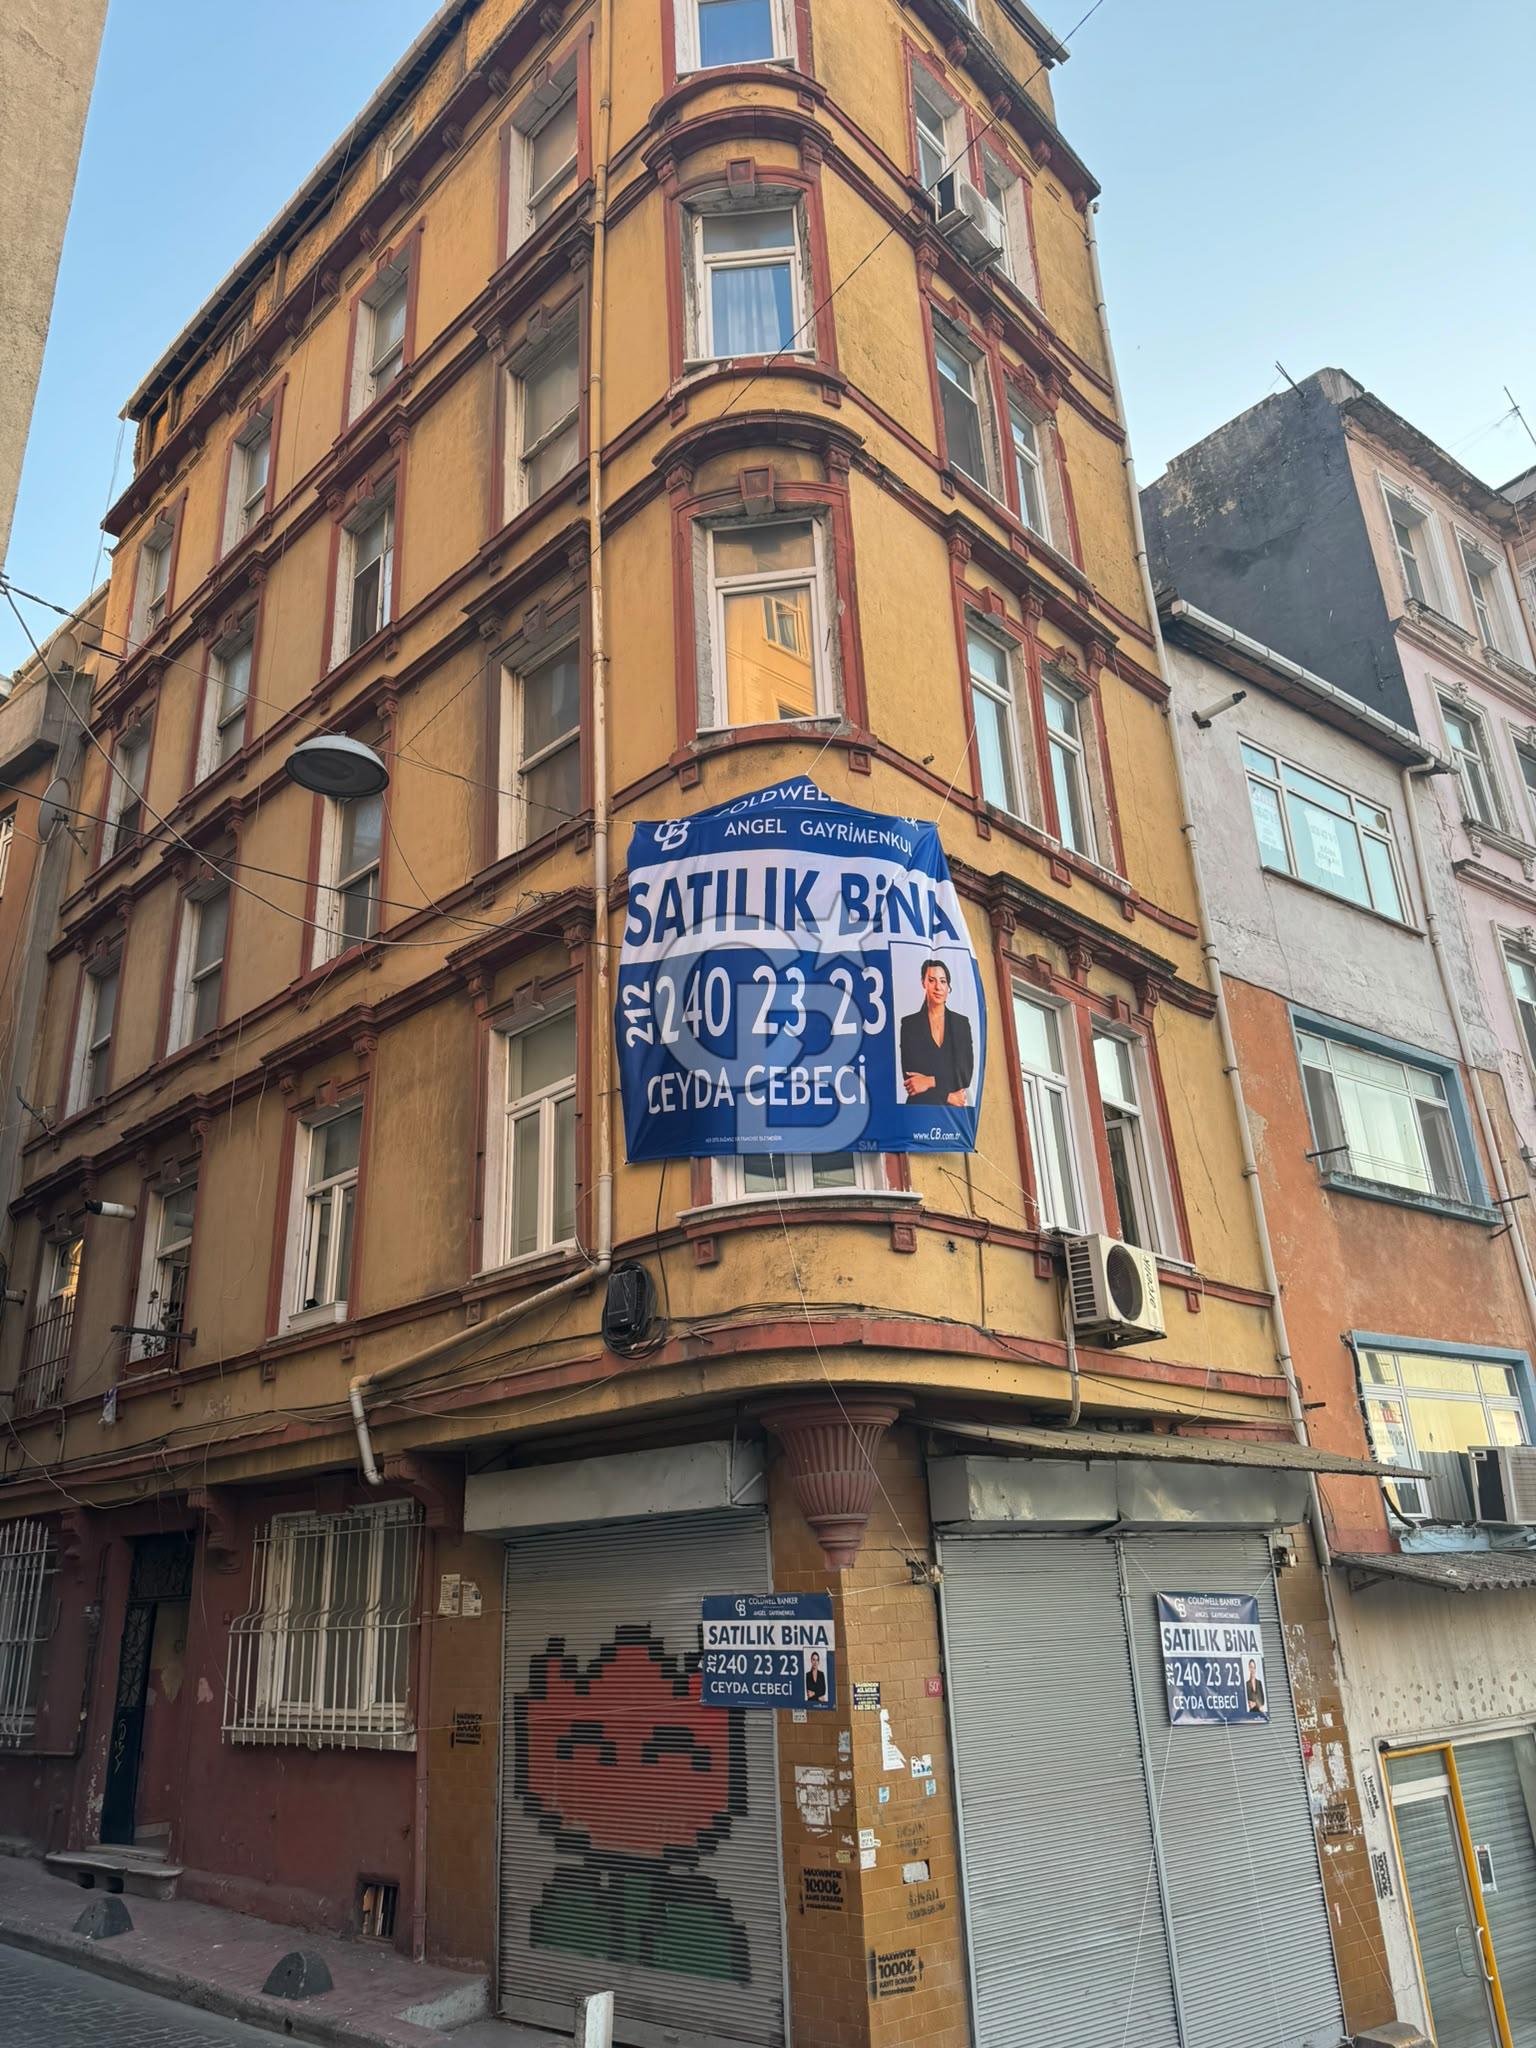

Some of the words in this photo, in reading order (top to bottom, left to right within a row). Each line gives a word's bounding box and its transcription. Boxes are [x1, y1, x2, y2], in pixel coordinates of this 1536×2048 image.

[724, 819, 787, 837] ANGEL
[625, 867, 820, 947] SATILIK
[622, 980, 654, 1048] 212
[656, 966, 731, 1045] 240
[751, 965, 807, 1037] 23
[829, 966, 887, 1036] 23
[647, 1066, 735, 1115] CEYDA
[744, 1054, 867, 1106] CEBECİ
[708, 1625, 776, 1645] SATILIK
[1163, 1627, 1221, 1652] SATILIK
[706, 1654, 718, 1674] 212
[717, 1654, 748, 1675] 240
[753, 1654, 774, 1676] 23
[779, 1654, 799, 1676] 23
[1174, 1662, 1201, 1687] 240
[1204, 1662, 1222, 1687] 23
[1225, 1662, 1241, 1687] 23
[710, 1681, 750, 1694] CEYDA
[751, 1680, 793, 1696] CEBECİ
[1172, 1695, 1205, 1710] CEYDA
[1206, 1692, 1240, 1710] CEBECİ
